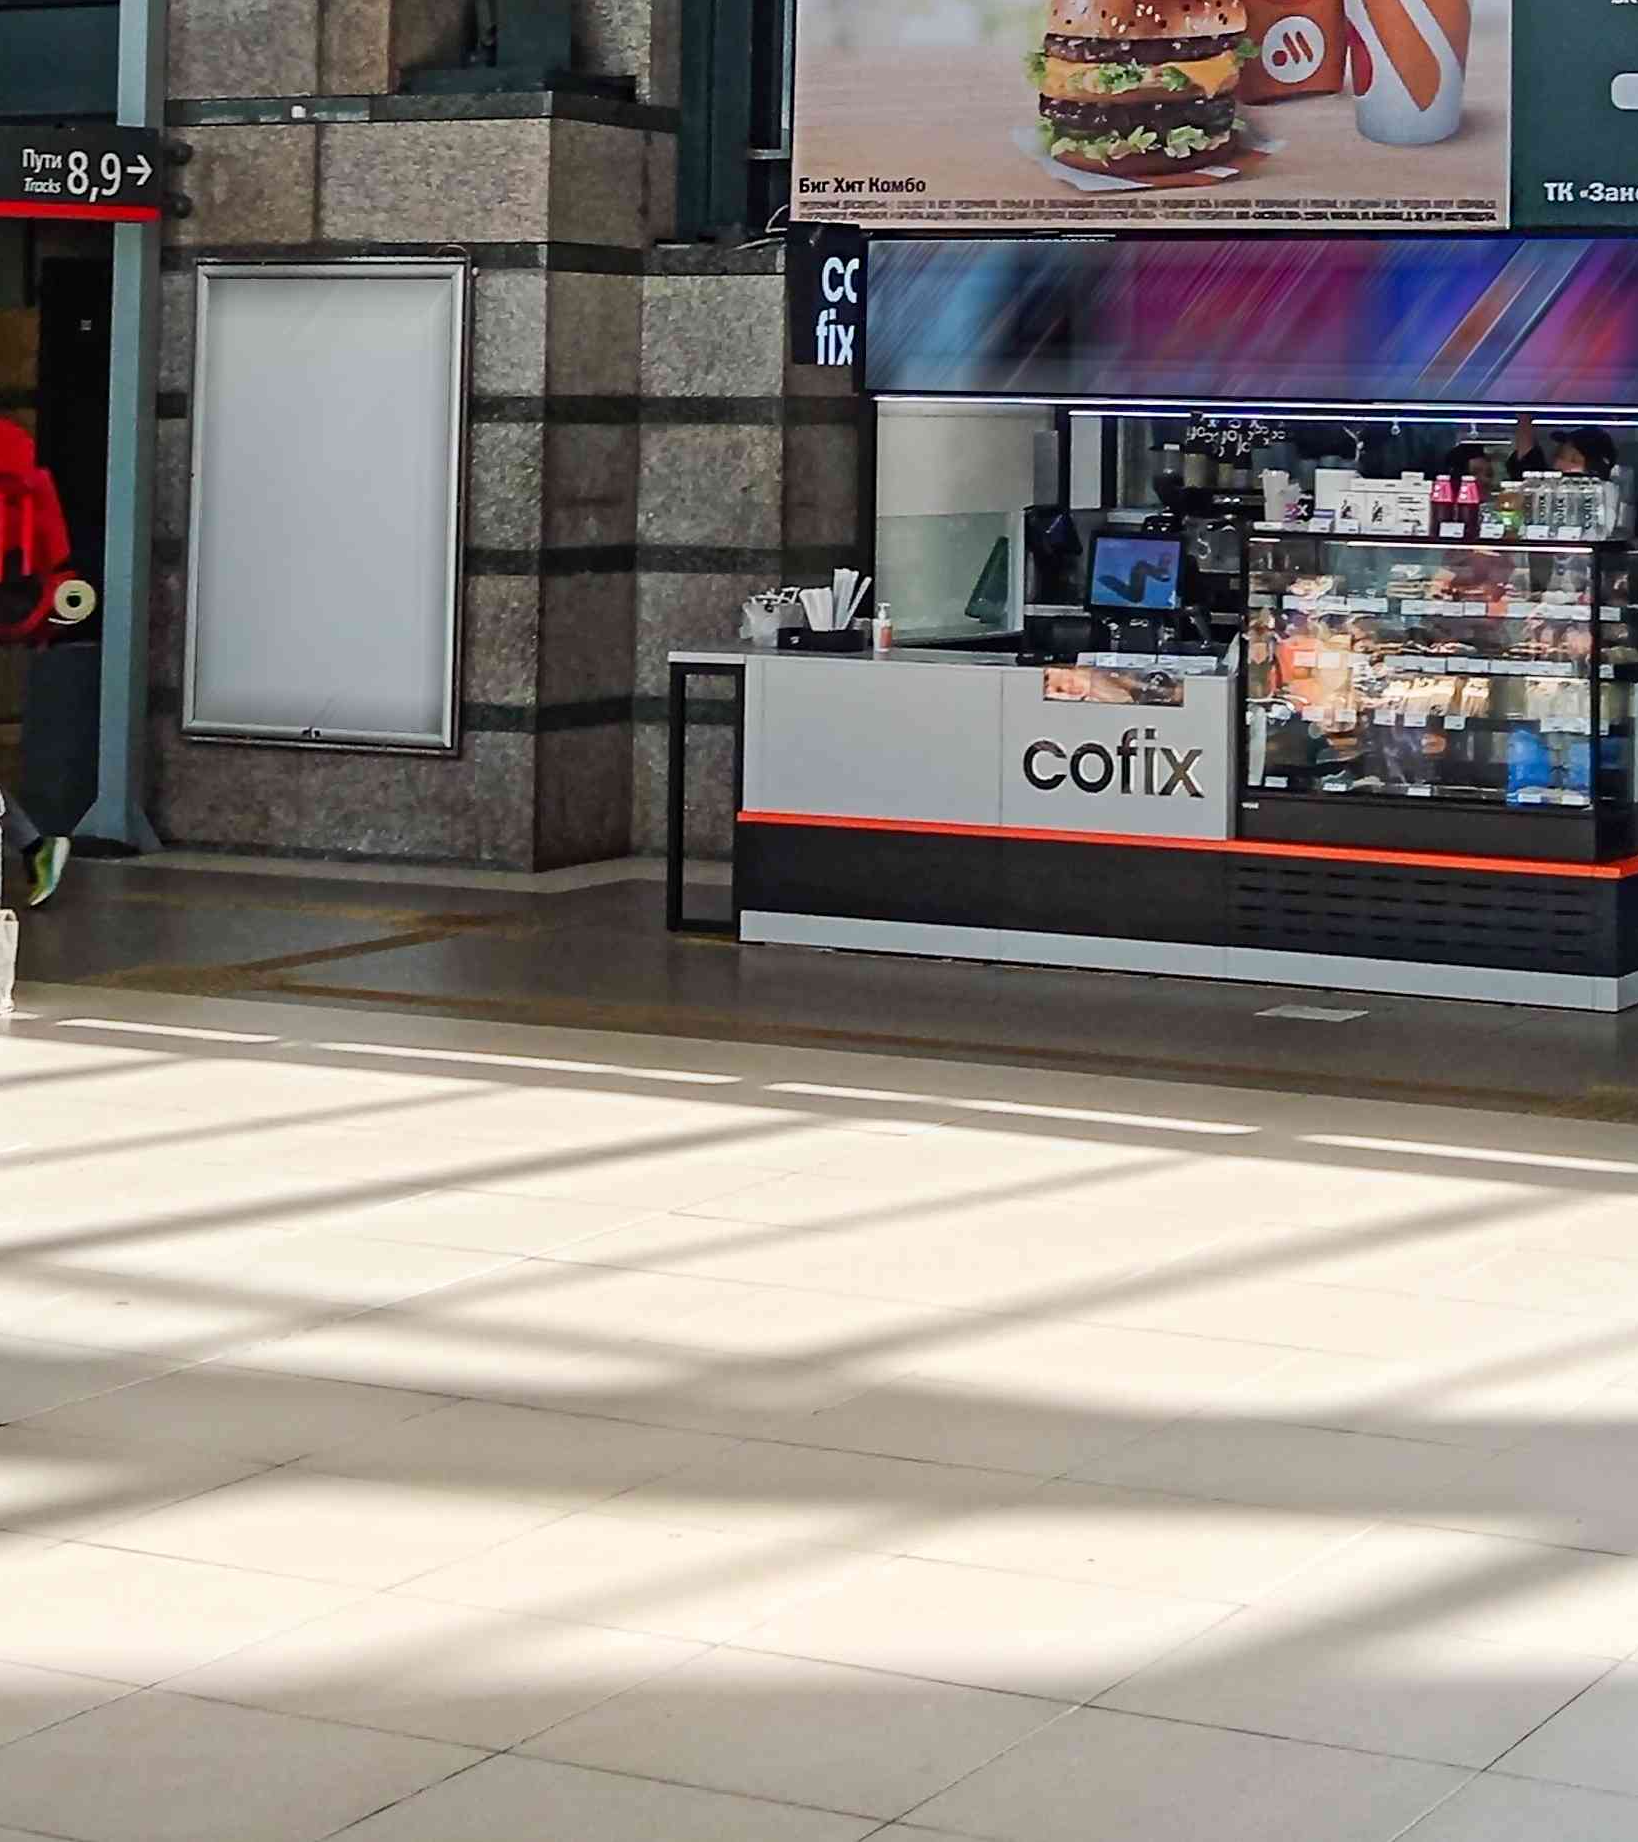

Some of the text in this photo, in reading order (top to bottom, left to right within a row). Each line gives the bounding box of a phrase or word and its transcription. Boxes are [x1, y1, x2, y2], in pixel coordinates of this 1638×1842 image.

[21, 148, 63, 174] Пути
[23, 177, 62, 194] Tracks
[66, 150, 123, 203] 8,9
[798, 177, 927, 194] Биг Хит Комбо
[1543, 182, 1574, 202] ТК
[816, 308, 855, 366] fix
[1022, 726, 1206, 800] cofix
